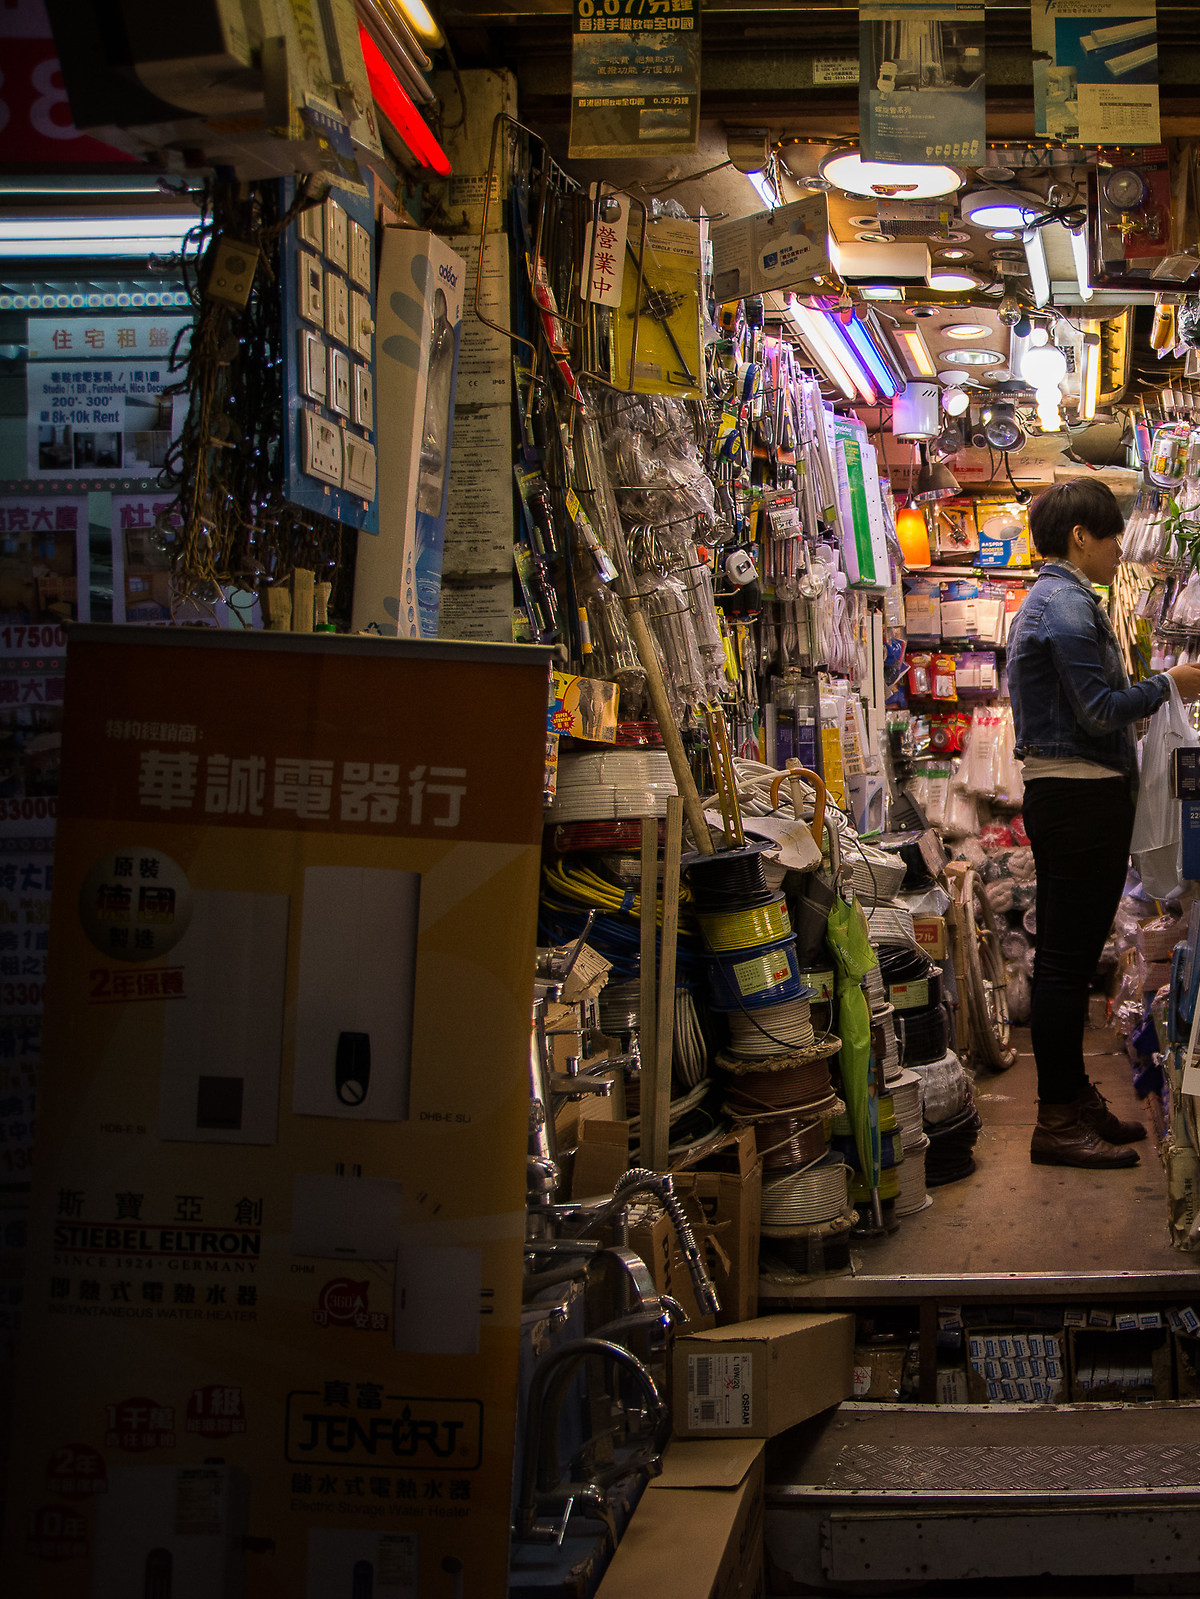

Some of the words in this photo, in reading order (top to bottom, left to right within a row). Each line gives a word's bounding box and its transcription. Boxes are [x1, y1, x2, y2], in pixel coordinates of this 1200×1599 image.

[592, 225, 618, 299] 營業中
[52, 328, 169, 350] 住宅租盤
[43, 385, 66, 395] Studio
[130, 384, 145, 394] Nice
[52, 411, 89, 423] 8k-10k
[93, 411, 120, 423] Rent
[0, 506, 78, 531] 克大廈
[2, 626, 66, 649] 17500
[138, 748, 467, 828] 華誠電器行
[113, 857, 160, 879] 原裝
[96, 884, 176, 924] 德國
[109, 927, 155, 950] 製造
[89, 967, 186, 999] 2年保養
[57, 1188, 264, 1226] 斯寶亞創
[54, 1226, 152, 1251] STIEBEL
[159, 1229, 260, 1255] ELTRON
[54, 1254, 108, 1268] SINCE
[115, 1257, 154, 1271] 1924
[167, 1258, 259, 1274] GERMANY
[49, 1276, 259, 1307] 即熱式電熱水器
[157, 1307, 203, 1320] WATER
[208, 1309, 259, 1322] HEATER
[323, 1380, 384, 1410] 真富
[742, 1393, 750, 1425] OSRAM
[291, 1473, 472, 1501] 儲水式電熱水器
[290, 1500, 334, 1514] Electric
[338, 1502, 386, 1518] Storage
[389, 1503, 427, 1516] Water
[428, 1504, 471, 1519] Heater
